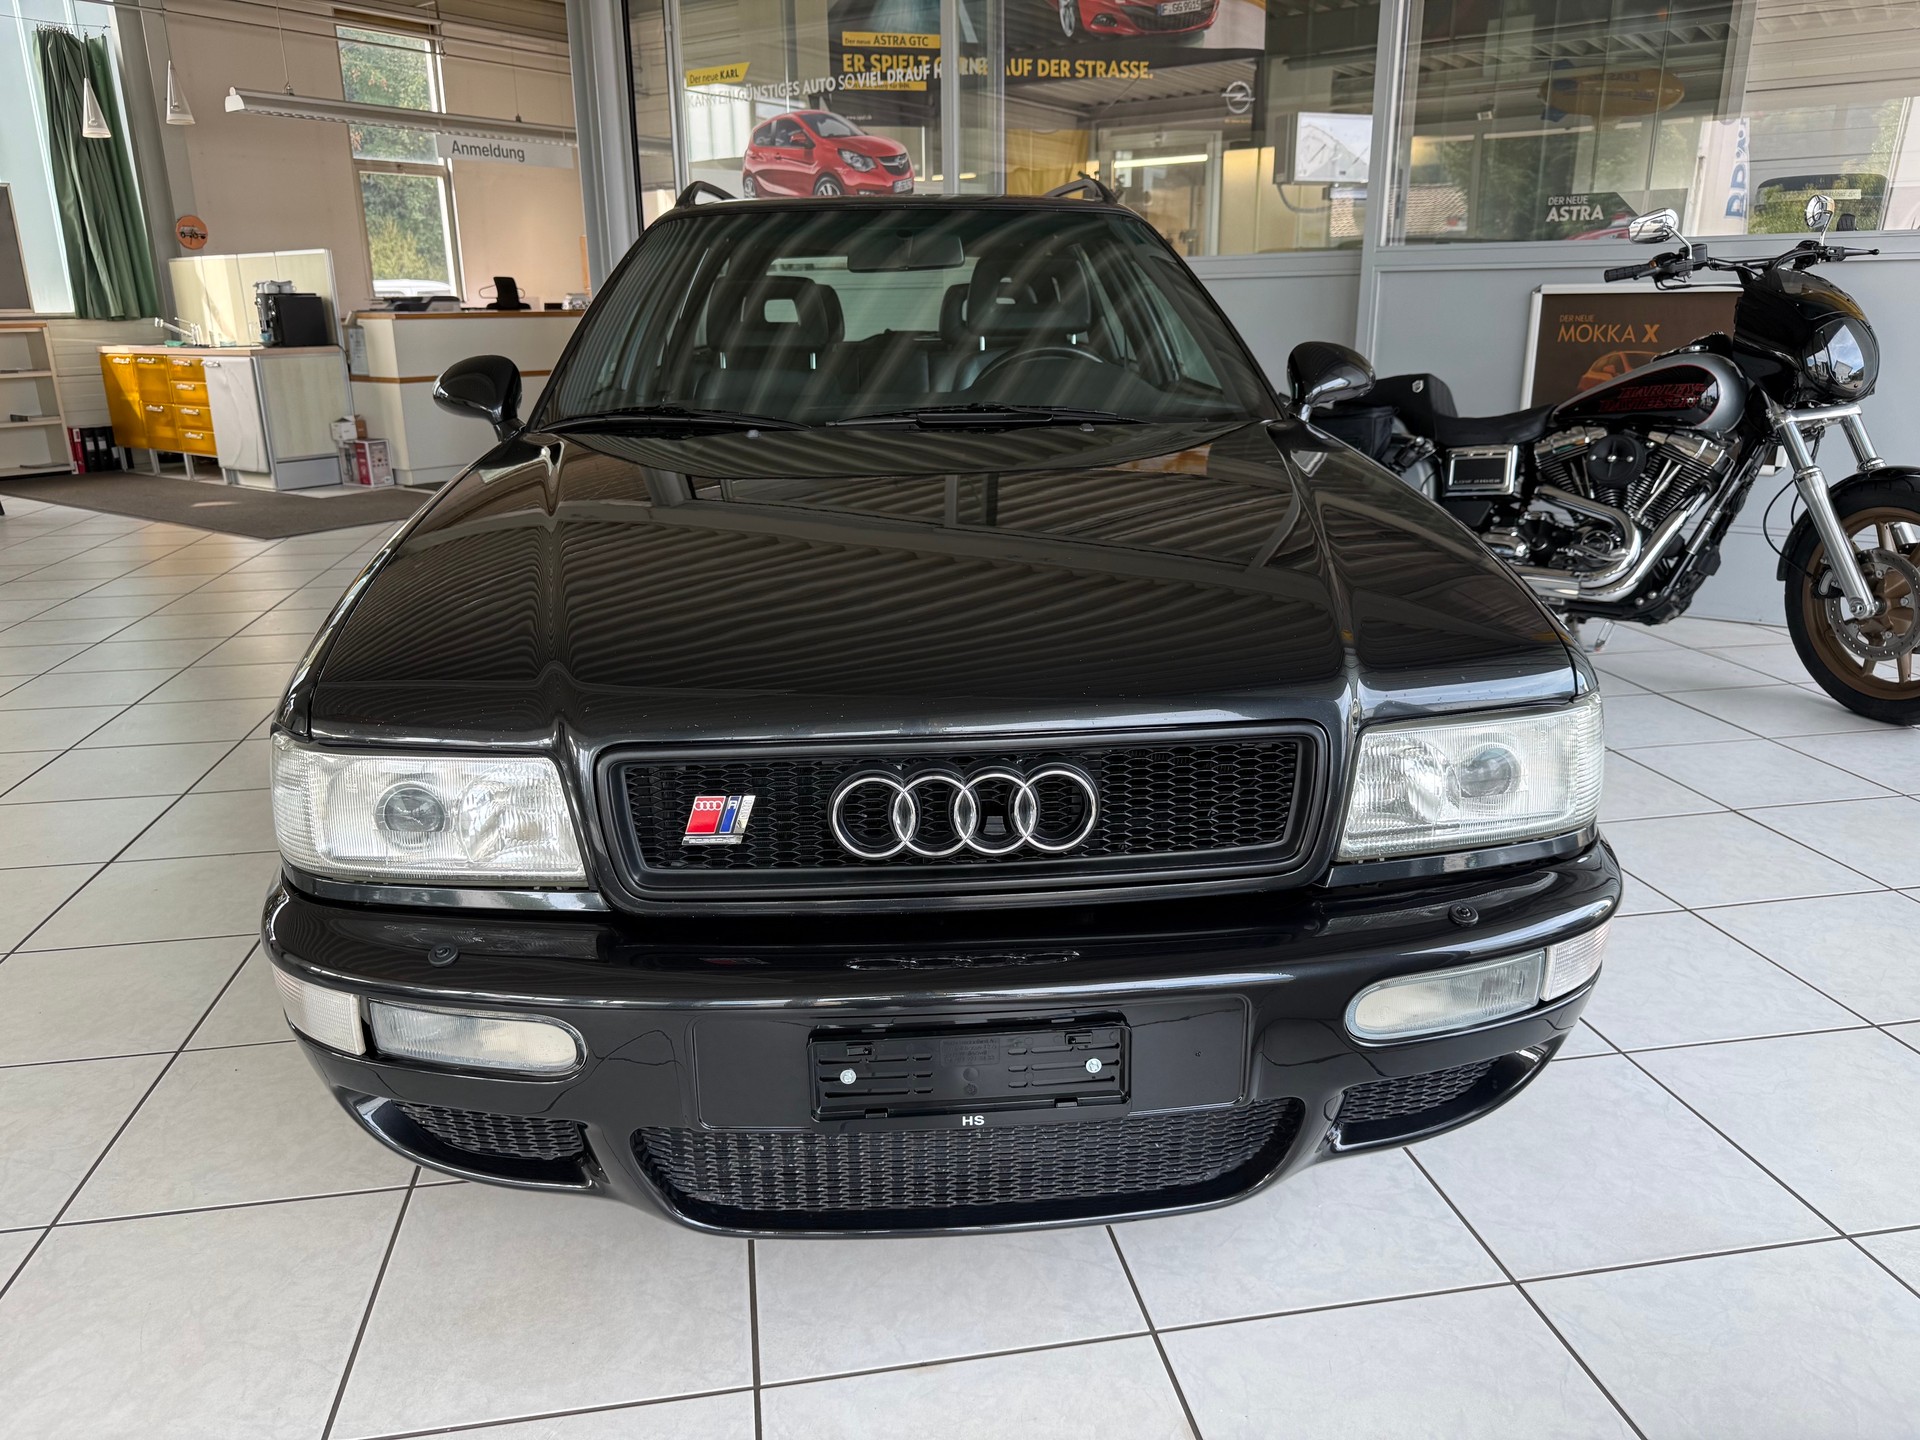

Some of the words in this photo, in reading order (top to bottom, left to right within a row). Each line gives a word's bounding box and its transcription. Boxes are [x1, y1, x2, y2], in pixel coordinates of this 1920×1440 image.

[873, 35, 907, 46] ASTRA
[909, 36, 929, 47] GTC
[842, 53, 866, 73] ER
[869, 54, 930, 74] SPIELT
[1037, 58, 1071, 78] DER
[1075, 60, 1154, 79] STRASSE.
[689, 74, 702, 84] Der
[702, 73, 719, 82] neue
[719, 68, 740, 79] KARL
[738, 81, 801, 102] GÜNSTIGES
[802, 76, 836, 95] AUTO
[838, 72, 855, 91] SO
[856, 70, 883, 88] VIEL
[886, 62, 930, 84] DRAUF
[451, 140, 526, 162] Anmeldung
[1547, 196, 1564, 206] DER
[1565, 195, 1589, 205] NEUE
[1545, 204, 1604, 222] ASTRA
[1559, 314, 1574, 323] DER
[1574, 314, 1595, 323] NEUE
[1557, 323, 1636, 343] MOKKA
[1641, 323, 1660, 343] X
[962, 1115, 985, 1127] HS
